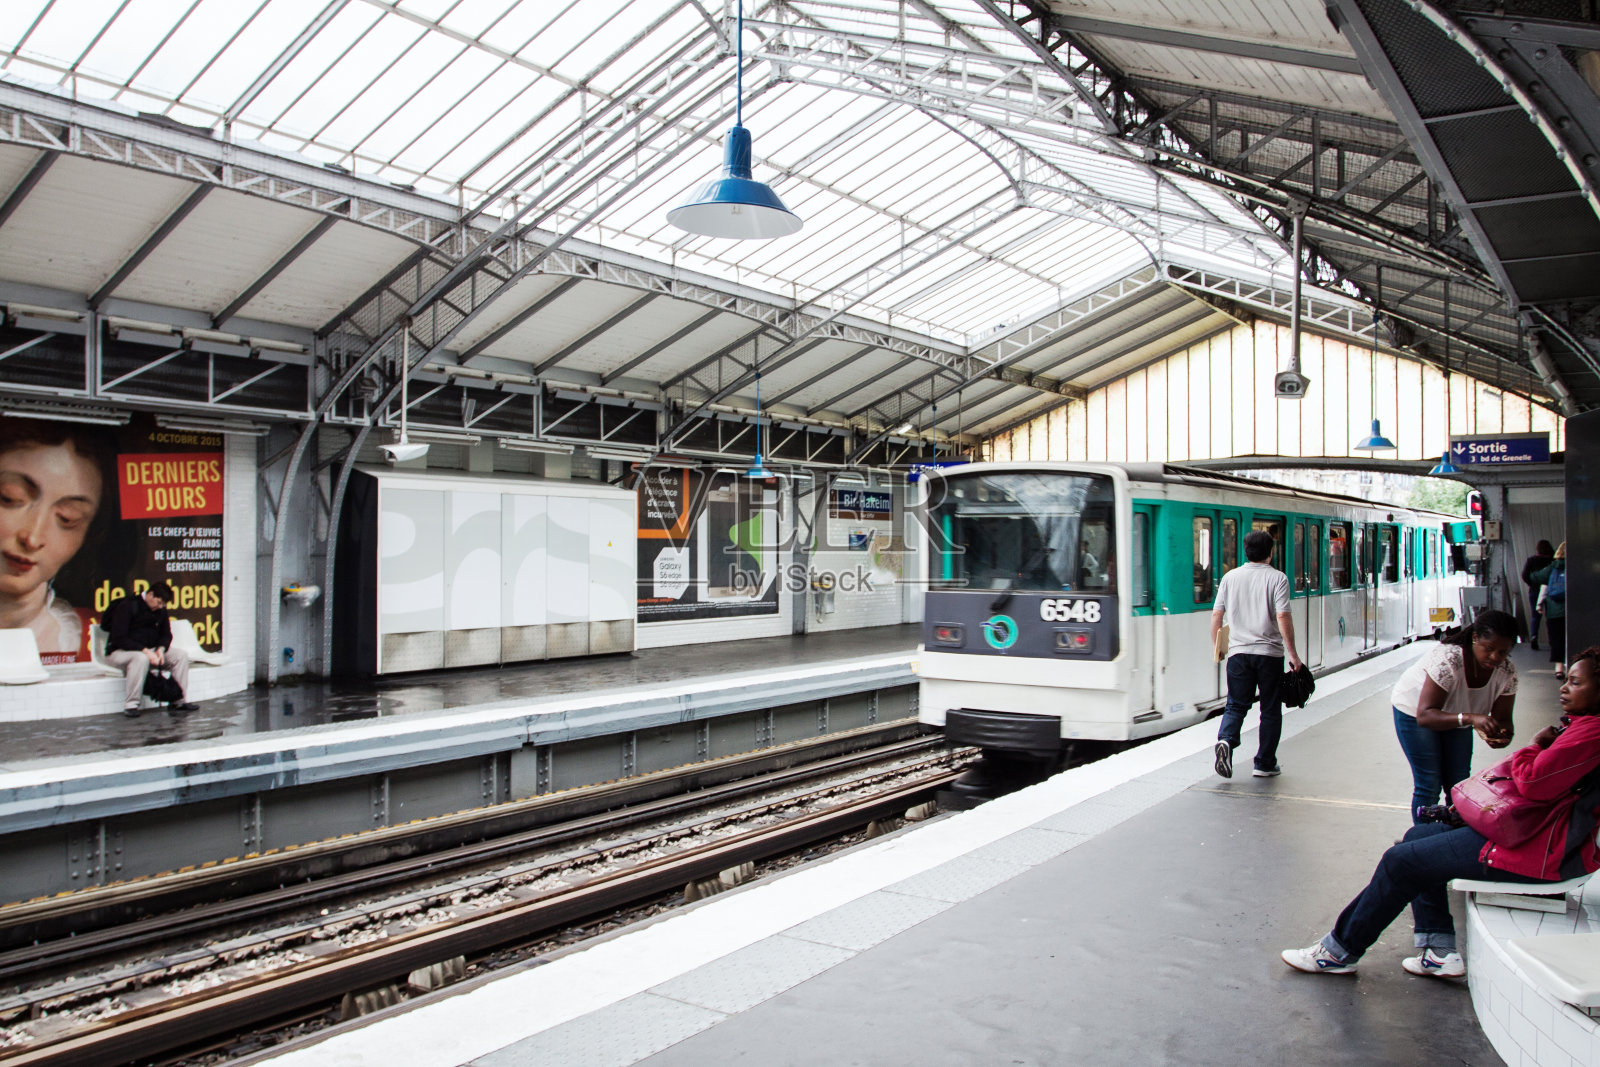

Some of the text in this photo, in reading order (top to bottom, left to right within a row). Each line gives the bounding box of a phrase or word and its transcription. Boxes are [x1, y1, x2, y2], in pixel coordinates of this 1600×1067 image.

[148, 432, 222, 447] 4 OCTOBRE 2015
[1468, 442, 1508, 454] Sortie
[1501, 454, 1532, 462] Grenelle
[126, 460, 221, 486] DERNIERS
[146, 486, 207, 512] JOURS
[843, 493, 891, 509] Bir-Hakeim
[148, 526, 162, 537] LES
[183, 538, 221, 548] FLAMANDS
[154, 550, 220, 560] DE LA COLLECTION
[166, 561, 221, 572] GERSTENMAIER
[660, 562, 681, 571] Galaxy
[95, 580, 126, 613] de
[1040, 599, 1101, 623] 6548
[41, 655, 76, 665] MADELEINE
